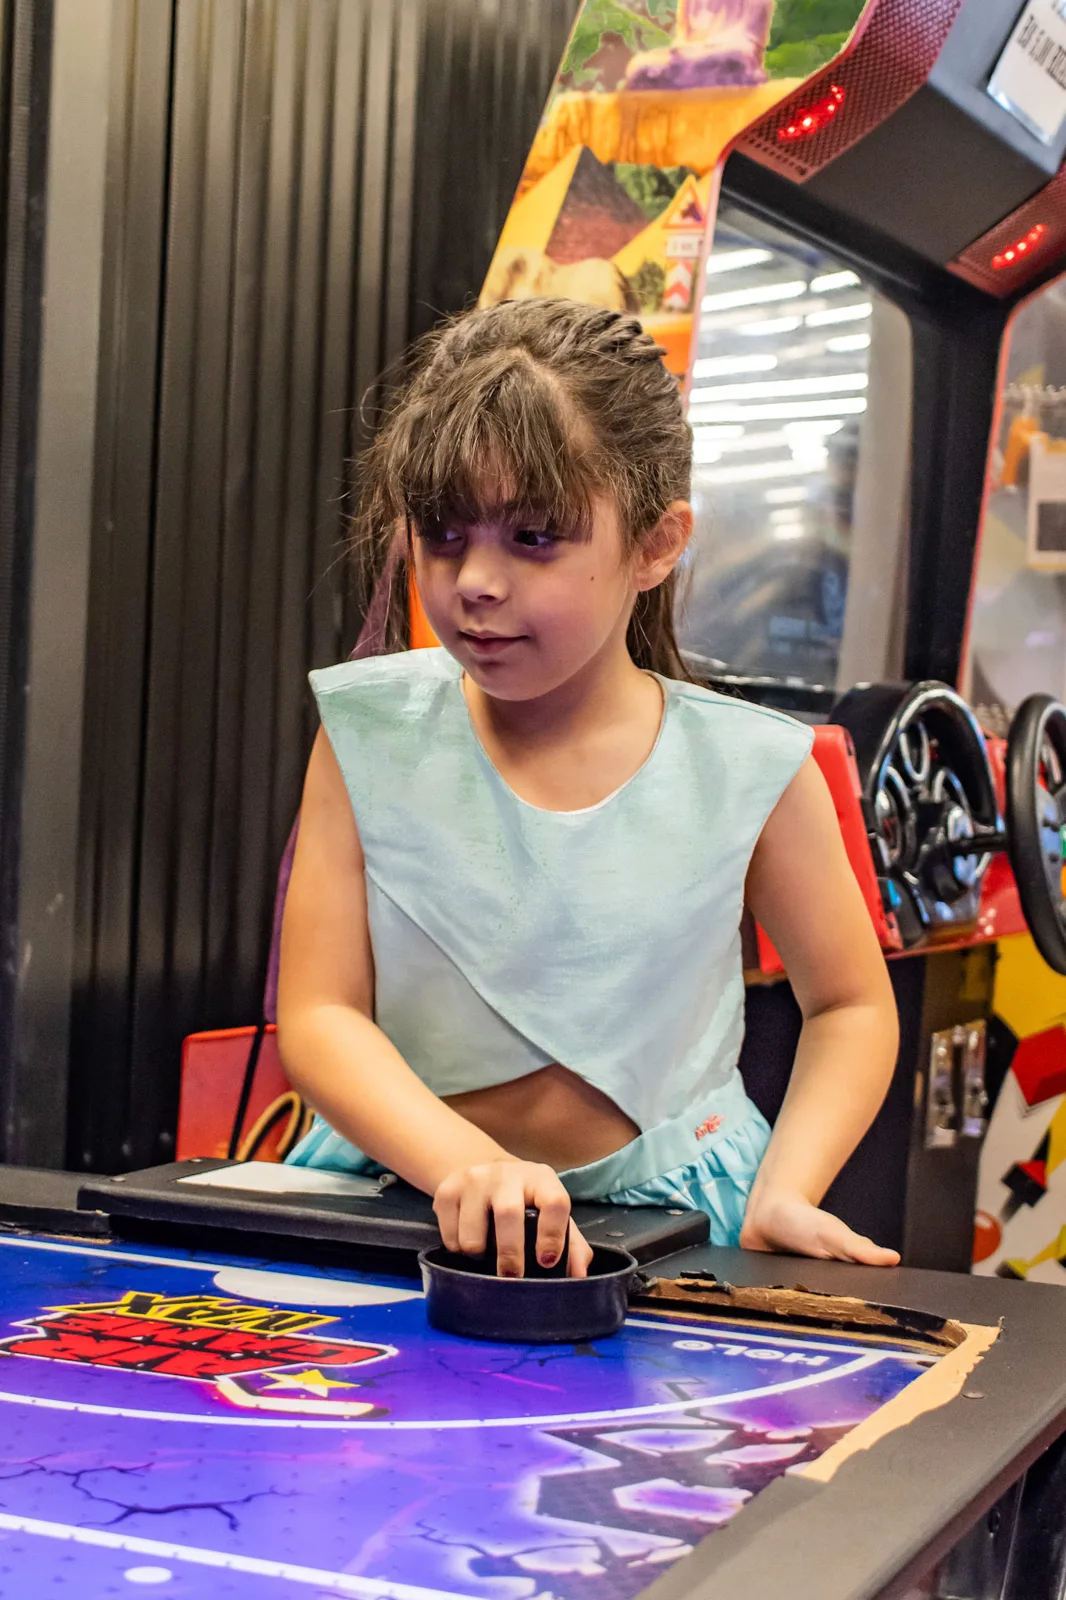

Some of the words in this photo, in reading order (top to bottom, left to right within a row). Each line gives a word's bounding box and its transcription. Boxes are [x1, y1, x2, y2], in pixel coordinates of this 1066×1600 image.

[42, 1291, 341, 1335] MAX
[8, 1332, 291, 1378] AIR
[38, 1312, 383, 1365] GAME
[672, 1339, 831, 1366] HOLO
